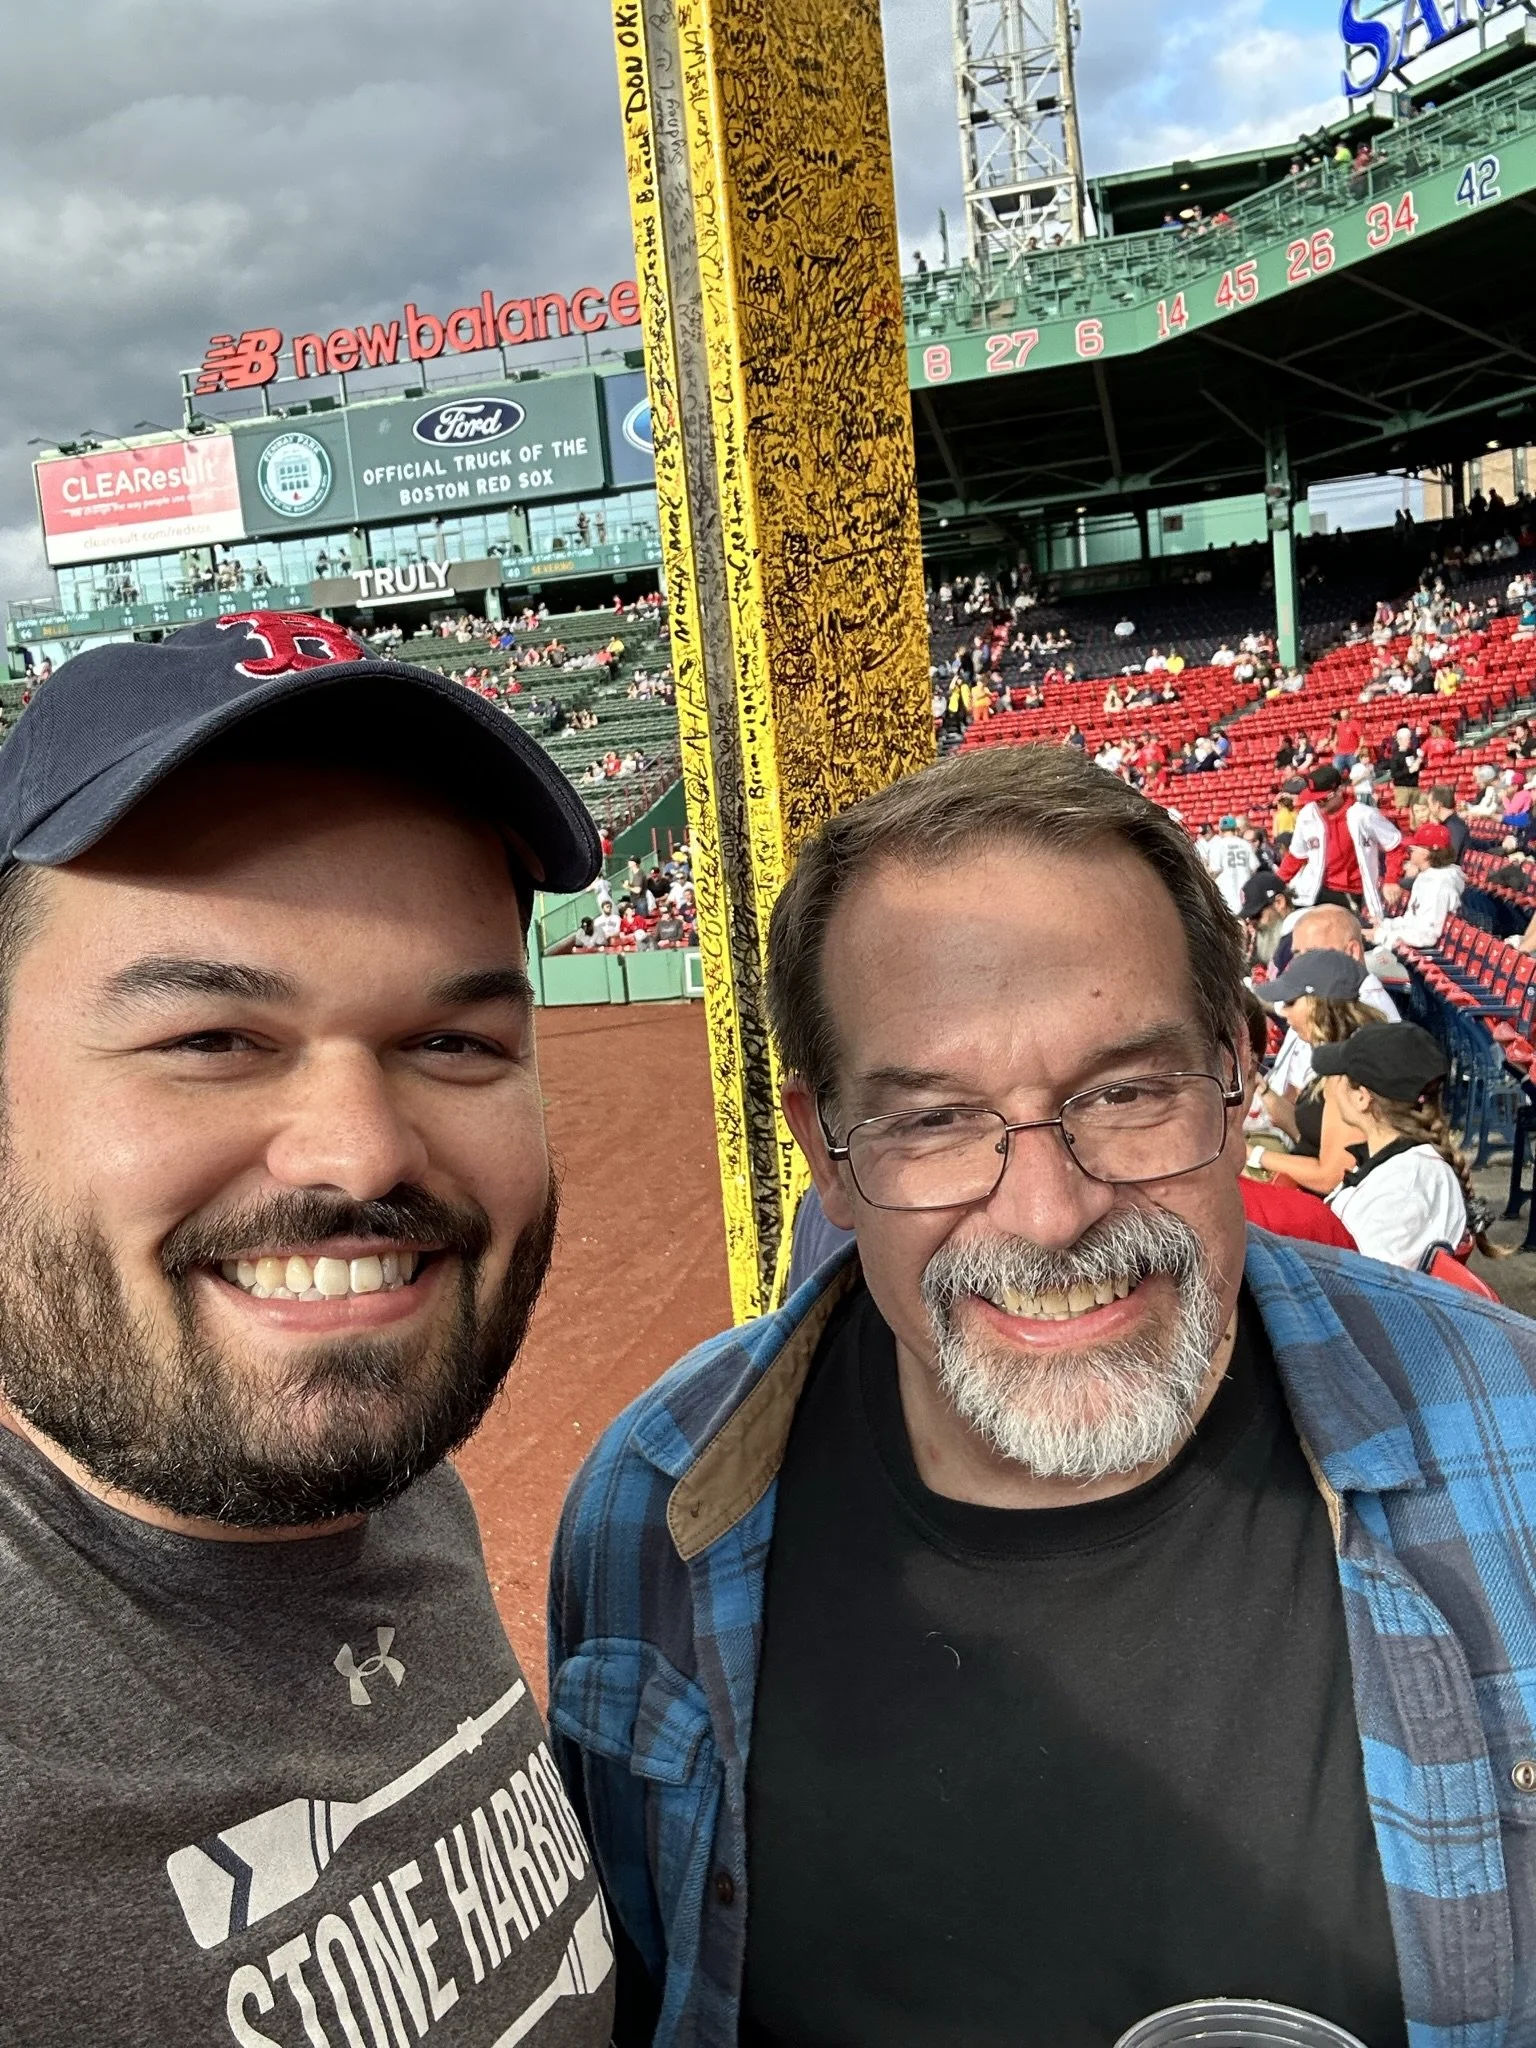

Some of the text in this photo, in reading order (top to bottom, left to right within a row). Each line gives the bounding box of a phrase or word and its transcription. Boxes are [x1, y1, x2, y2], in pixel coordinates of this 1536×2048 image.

[922, 155, 1501, 383] 8 27 6 14 45 26 34 42
[434, 404, 503, 441] Ford
[62, 458, 217, 503] CLEAResult
[363, 438, 588, 486] OFFICIAL TRUCK OF THE
[400, 468, 554, 506] BOSTON RED SOX
[352, 559, 451, 598] TRULY
[215, 611, 368, 680] B
[1227, 850, 1248, 868] 25
[226, 1860, 459, 2048] STONE
